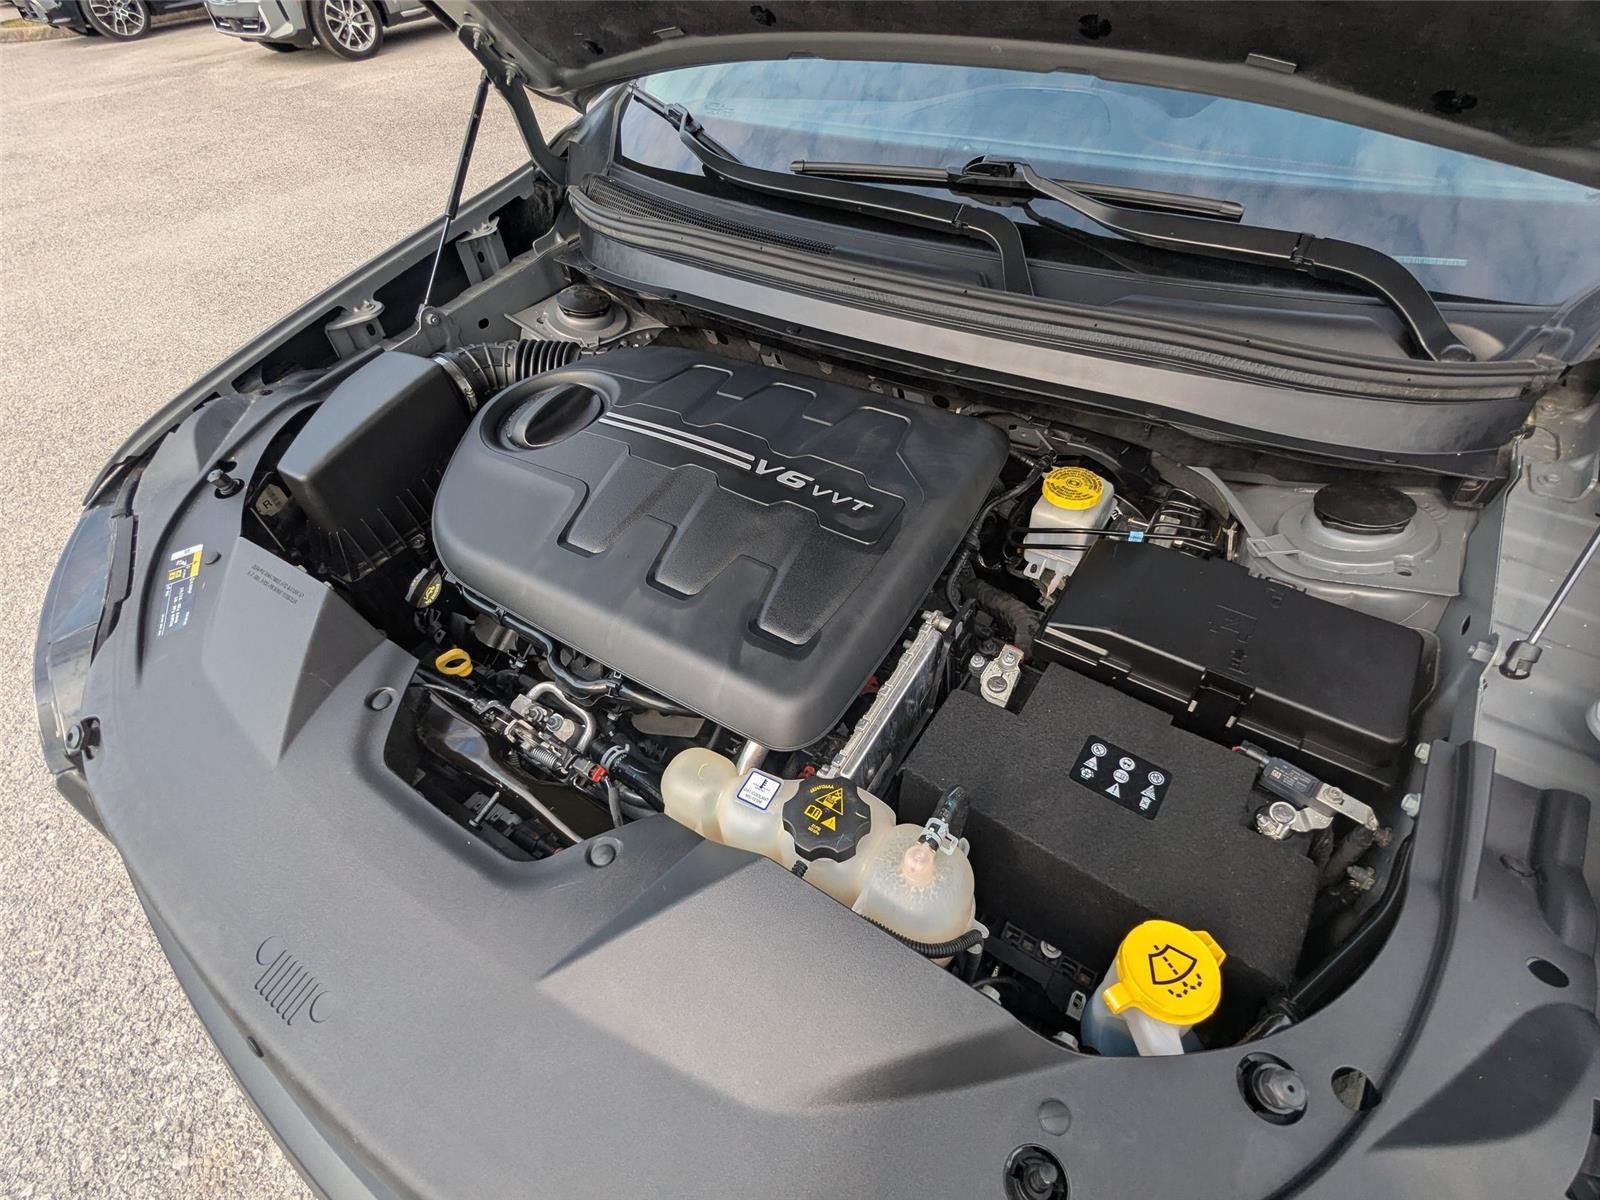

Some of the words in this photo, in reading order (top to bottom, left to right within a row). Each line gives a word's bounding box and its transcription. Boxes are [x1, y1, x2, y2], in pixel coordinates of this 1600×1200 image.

[755, 458, 815, 489] V6
[812, 484, 874, 511] VVT
[262, 499, 273, 510] R
